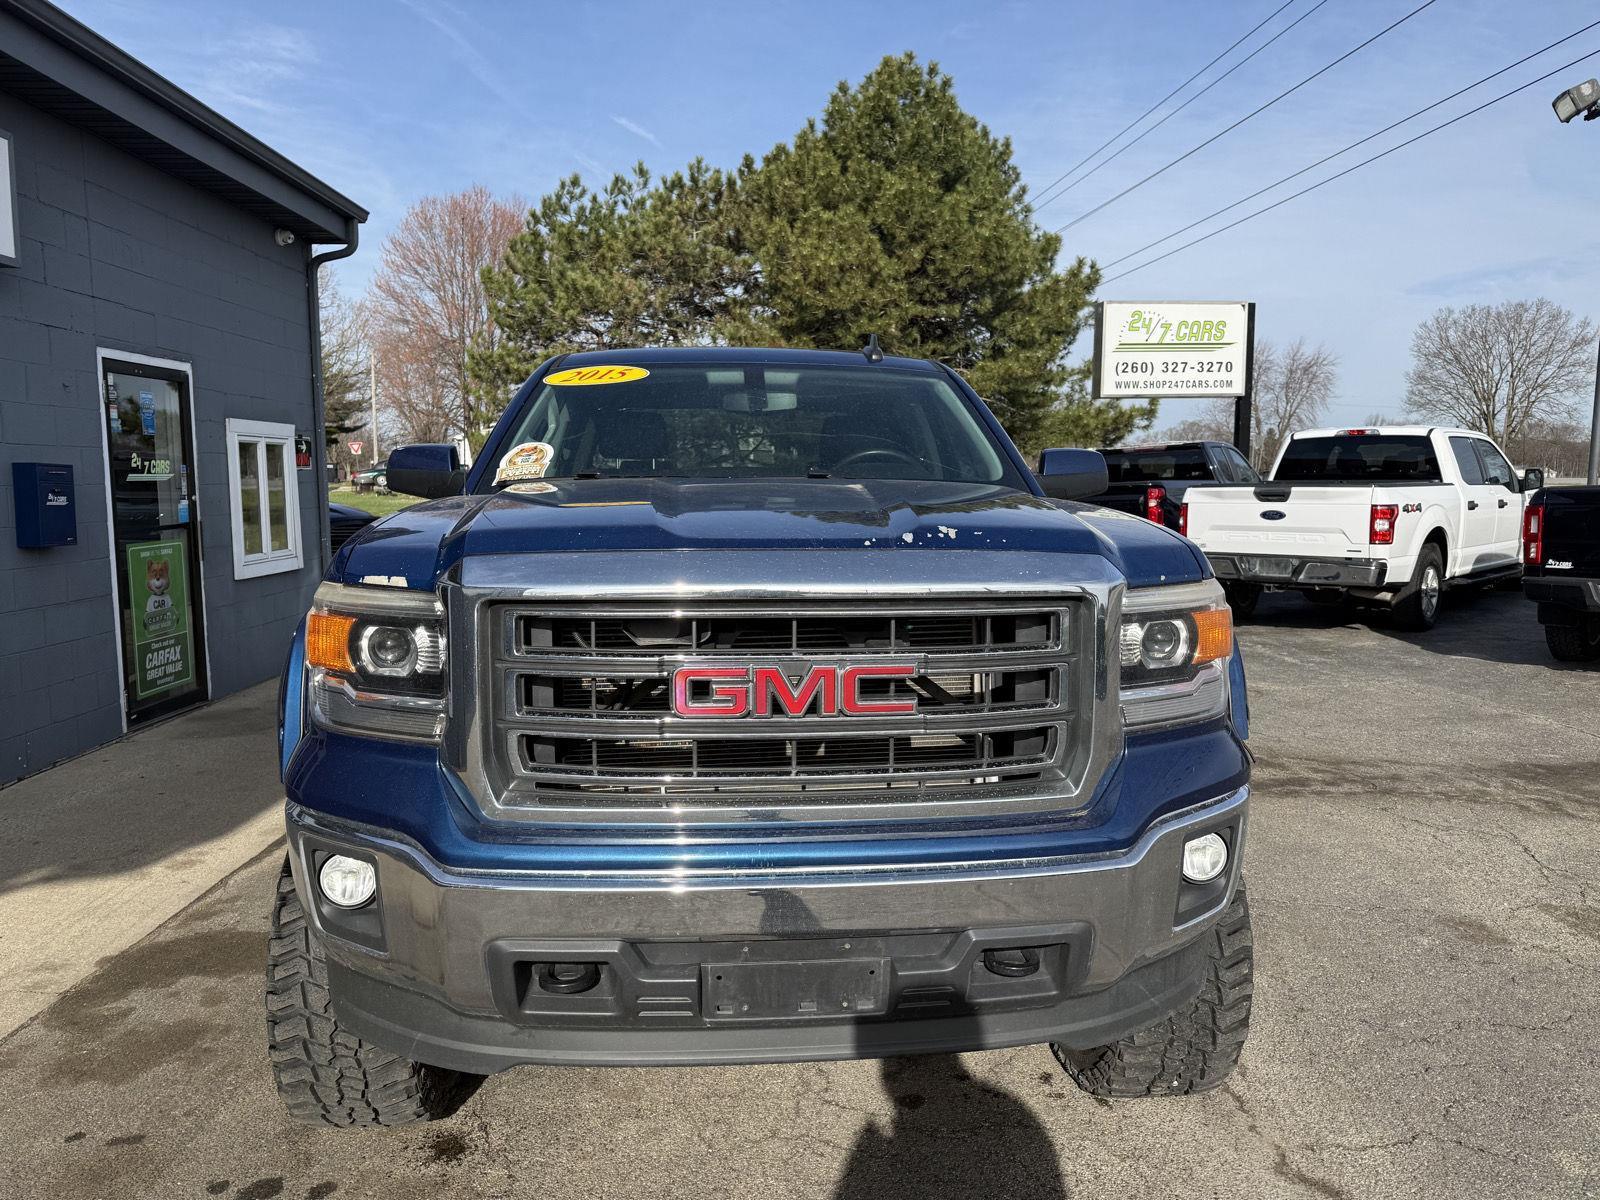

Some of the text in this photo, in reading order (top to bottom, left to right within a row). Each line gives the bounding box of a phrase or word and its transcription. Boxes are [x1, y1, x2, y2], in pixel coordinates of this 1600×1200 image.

[1175, 320, 1227, 342] CARS
[560, 368, 633, 383] 2015
[1115, 361, 1233, 376] (260) 327-3270
[1115, 379, 1233, 389] WWW.SHOP247CARS.COM
[150, 460, 170, 474] CARS
[146, 645, 181, 668] CARFAX
[146, 661, 183, 680] GREAT VALUE
[672, 664, 918, 719] GMC
